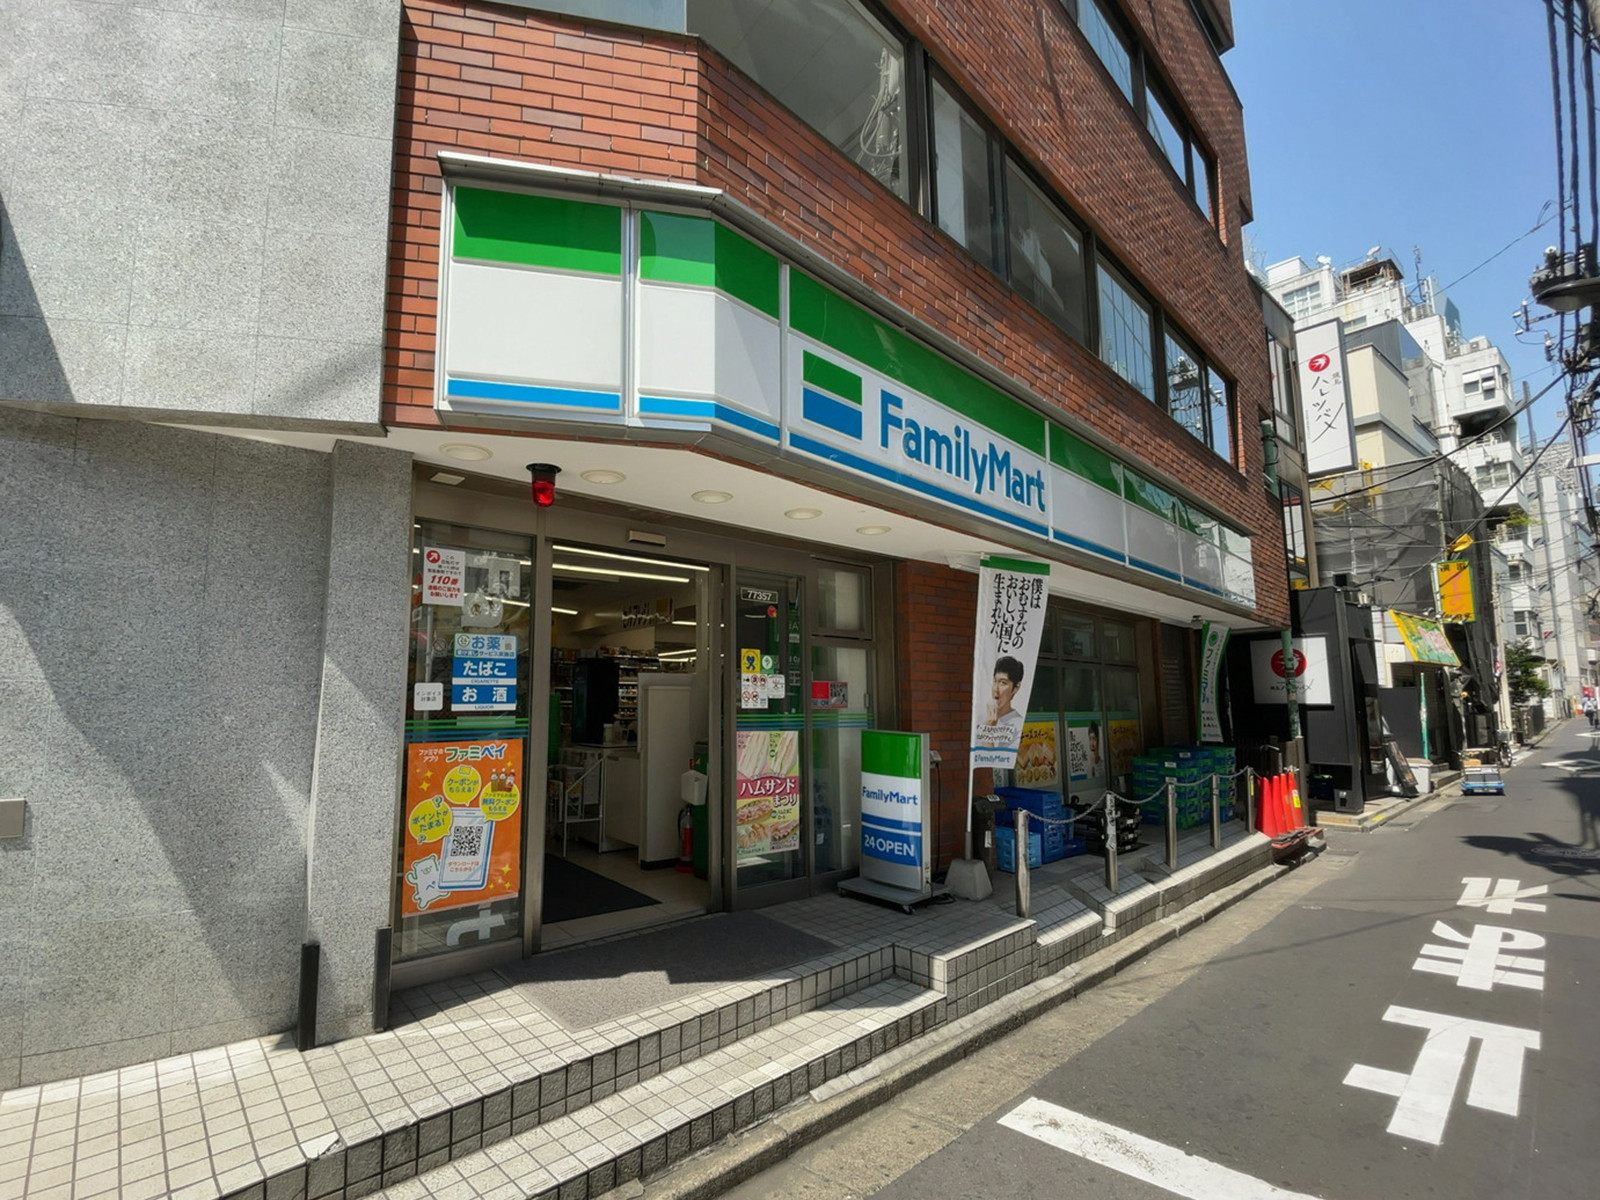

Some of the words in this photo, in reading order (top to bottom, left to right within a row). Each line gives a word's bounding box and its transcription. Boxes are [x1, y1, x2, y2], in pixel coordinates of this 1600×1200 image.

[881, 389, 1046, 512] FamilyMart
[747, 590, 772, 600] 77357
[1031, 578, 1043, 609] 僕は
[997, 575, 1018, 653] おいしい国に
[1012, 576, 1030, 649] おむすびの
[472, 636, 501, 650] お薬
[463, 661, 507, 676] たばこ
[445, 743, 507, 763] ファミペイ
[978, 754, 1010, 764] FamilyMart
[447, 778, 479, 786] クーポンが
[740, 779, 795, 796] ハムサンド
[773, 793, 797, 807] まつり
[862, 786, 918, 806] FamilyMart
[412, 809, 449, 824] ポイントが
[1343, 877, 1548, 1146] 止まれ
